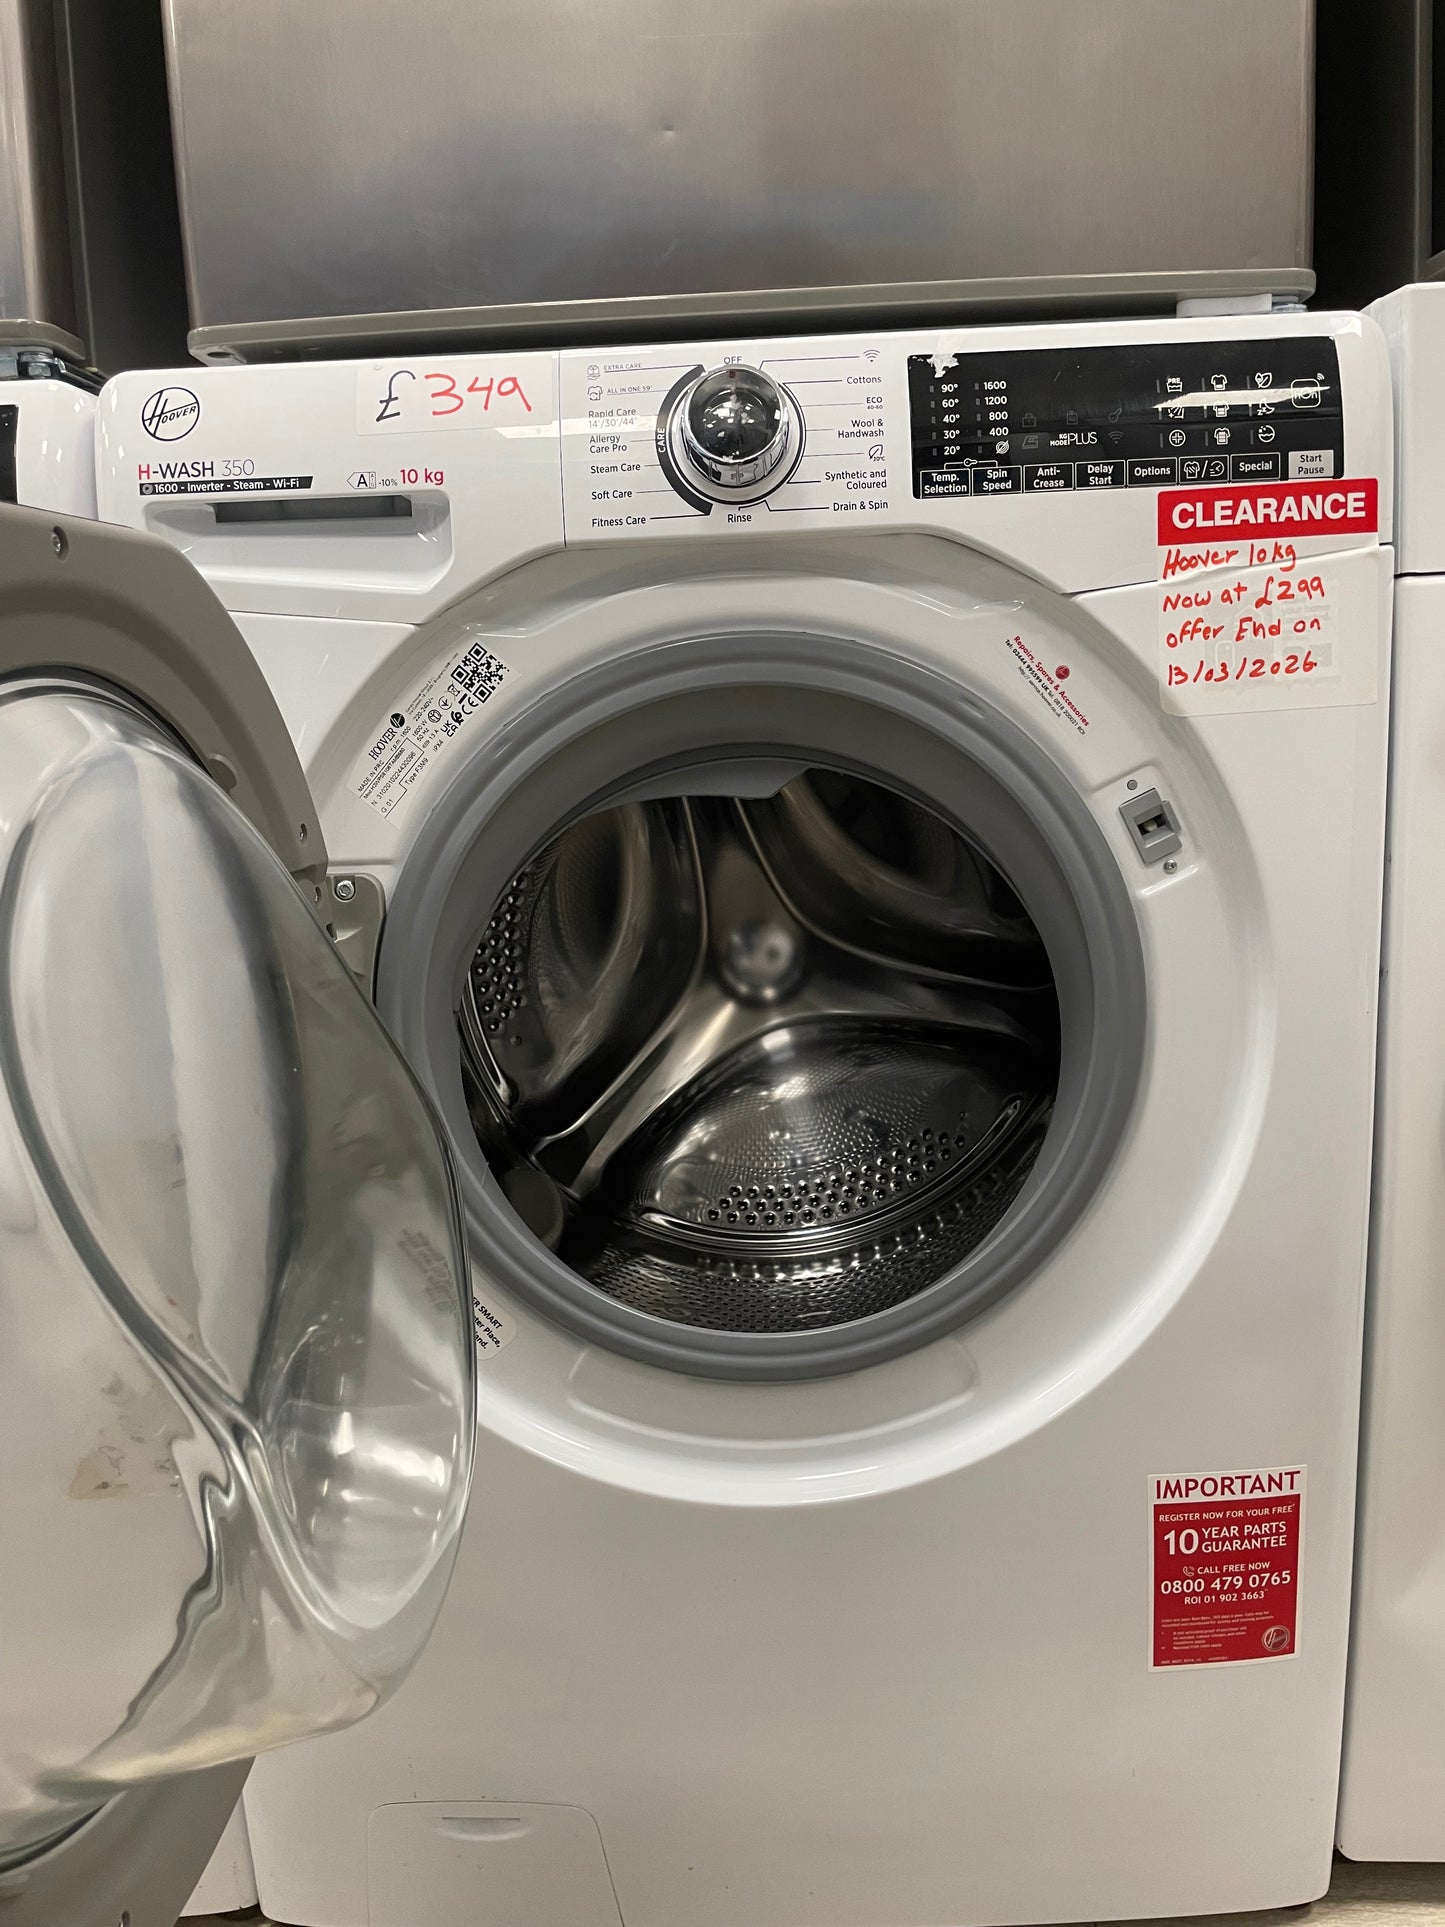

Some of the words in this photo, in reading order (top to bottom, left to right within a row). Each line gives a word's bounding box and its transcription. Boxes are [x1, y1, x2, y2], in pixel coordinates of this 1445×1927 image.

[723, 356, 742, 364] OFF
[846, 376, 881, 384] Cottons
[984, 381, 1007, 390] 1600
[941, 383, 958, 392] 90°
[942, 399, 959, 408] 60°
[985, 396, 1007, 405] 1200
[589, 410, 613, 418] Rapid
[616, 408, 636, 416] Care
[943, 414, 960, 423] 40°
[989, 411, 1008, 420] 800
[851, 419, 874, 428] Wool
[877, 418, 884, 426] &
[838, 428, 884, 438] Handwash
[944, 430, 960, 439] 30°
[989, 427, 1009, 436] 400
[589, 434, 621, 445] Allergy
[657, 428, 666, 453] CARE
[1068, 431, 1097, 445] PLUS
[590, 445, 609, 453] Care
[612, 444, 627, 452] Pro
[944, 446, 961, 455] 20°
[1300, 454, 1322, 463] Start
[138, 461, 214, 480] H-WASH
[222, 459, 255, 477] 350
[591, 465, 618, 474] Steam
[621, 463, 641, 472] Care
[1087, 464, 1114, 474] Delay
[1134, 466, 1171, 477] Options
[1239, 460, 1272, 472] Special
[1298, 465, 1324, 475] Pause
[400, 468, 418, 484] 10
[425, 468, 444, 486] kg
[825, 471, 867, 481] Synthetic
[870, 469, 886, 478] and
[987, 469, 1007, 479] Spin
[1037, 467, 1061, 477] Anti-
[379, 479, 398, 487] -10%
[932, 473, 959, 483] Temp.
[1034, 478, 1065, 489] Crease
[1089, 476, 1112, 485] Start
[155, 483, 178, 493] 1600
[188, 482, 224, 492] Inverter
[234, 480, 264, 490] Steam
[273, 478, 300, 488] Wi-Fi
[846, 480, 887, 490] Coloured
[924, 484, 967, 494] Selection
[983, 480, 1012, 491] Speed
[591, 491, 609, 500] Soft
[612, 490, 632, 498] Care
[833, 502, 857, 511] Drain
[860, 501, 866, 509] &
[869, 500, 888, 510] Spin
[1172, 491, 1366, 530] CLEARANCE
[592, 518, 623, 528] Fitness
[626, 516, 646, 525] Care
[728, 513, 752, 523] Rinse
[1162, 549, 1239, 579] Hoover
[1220, 581, 1247, 604] at
[1235, 616, 1281, 642] End
[1293, 617, 1321, 633] on
[1168, 650, 1317, 686] 13/03/2026
[1013, 635, 1034, 663] Repairs,
[1034, 661, 1054, 684] Spares
[1053, 683, 1060, 691] &
[1058, 690, 1089, 726] Accessories
[368, 727, 397, 760] HOOVER
[404, 772, 417, 784] Type
[478, 1306, 503, 1328] SMART
[483, 1327, 500, 1348] Place,
[1156, 1470, 1301, 1499] IMPORTANT
[1159, 1513, 1200, 1522] REGISTER
[1203, 1511, 1223, 1520] NOW
[1226, 1510, 1243, 1518] FOR
[1245, 1508, 1269, 1517] YOUR
[1164, 1529, 1199, 1555] 10
[1202, 1526, 1239, 1538] YEAR
[1244, 1521, 1286, 1536] PARTS
[1202, 1535, 1287, 1553] GUARANTEE
[1197, 1566, 1220, 1575] CALL
[1223, 1563, 1246, 1573] FREE
[1248, 1561, 1271, 1571] NOW
[1161, 1579, 1205, 1594] 0800
[1211, 1576, 1243, 1591] 479
[1248, 1571, 1291, 1588] 0765
[1184, 1596, 1201, 1605] ROI
[1204, 1595, 1216, 1604] 01
[1220, 1593, 1238, 1602] 902
